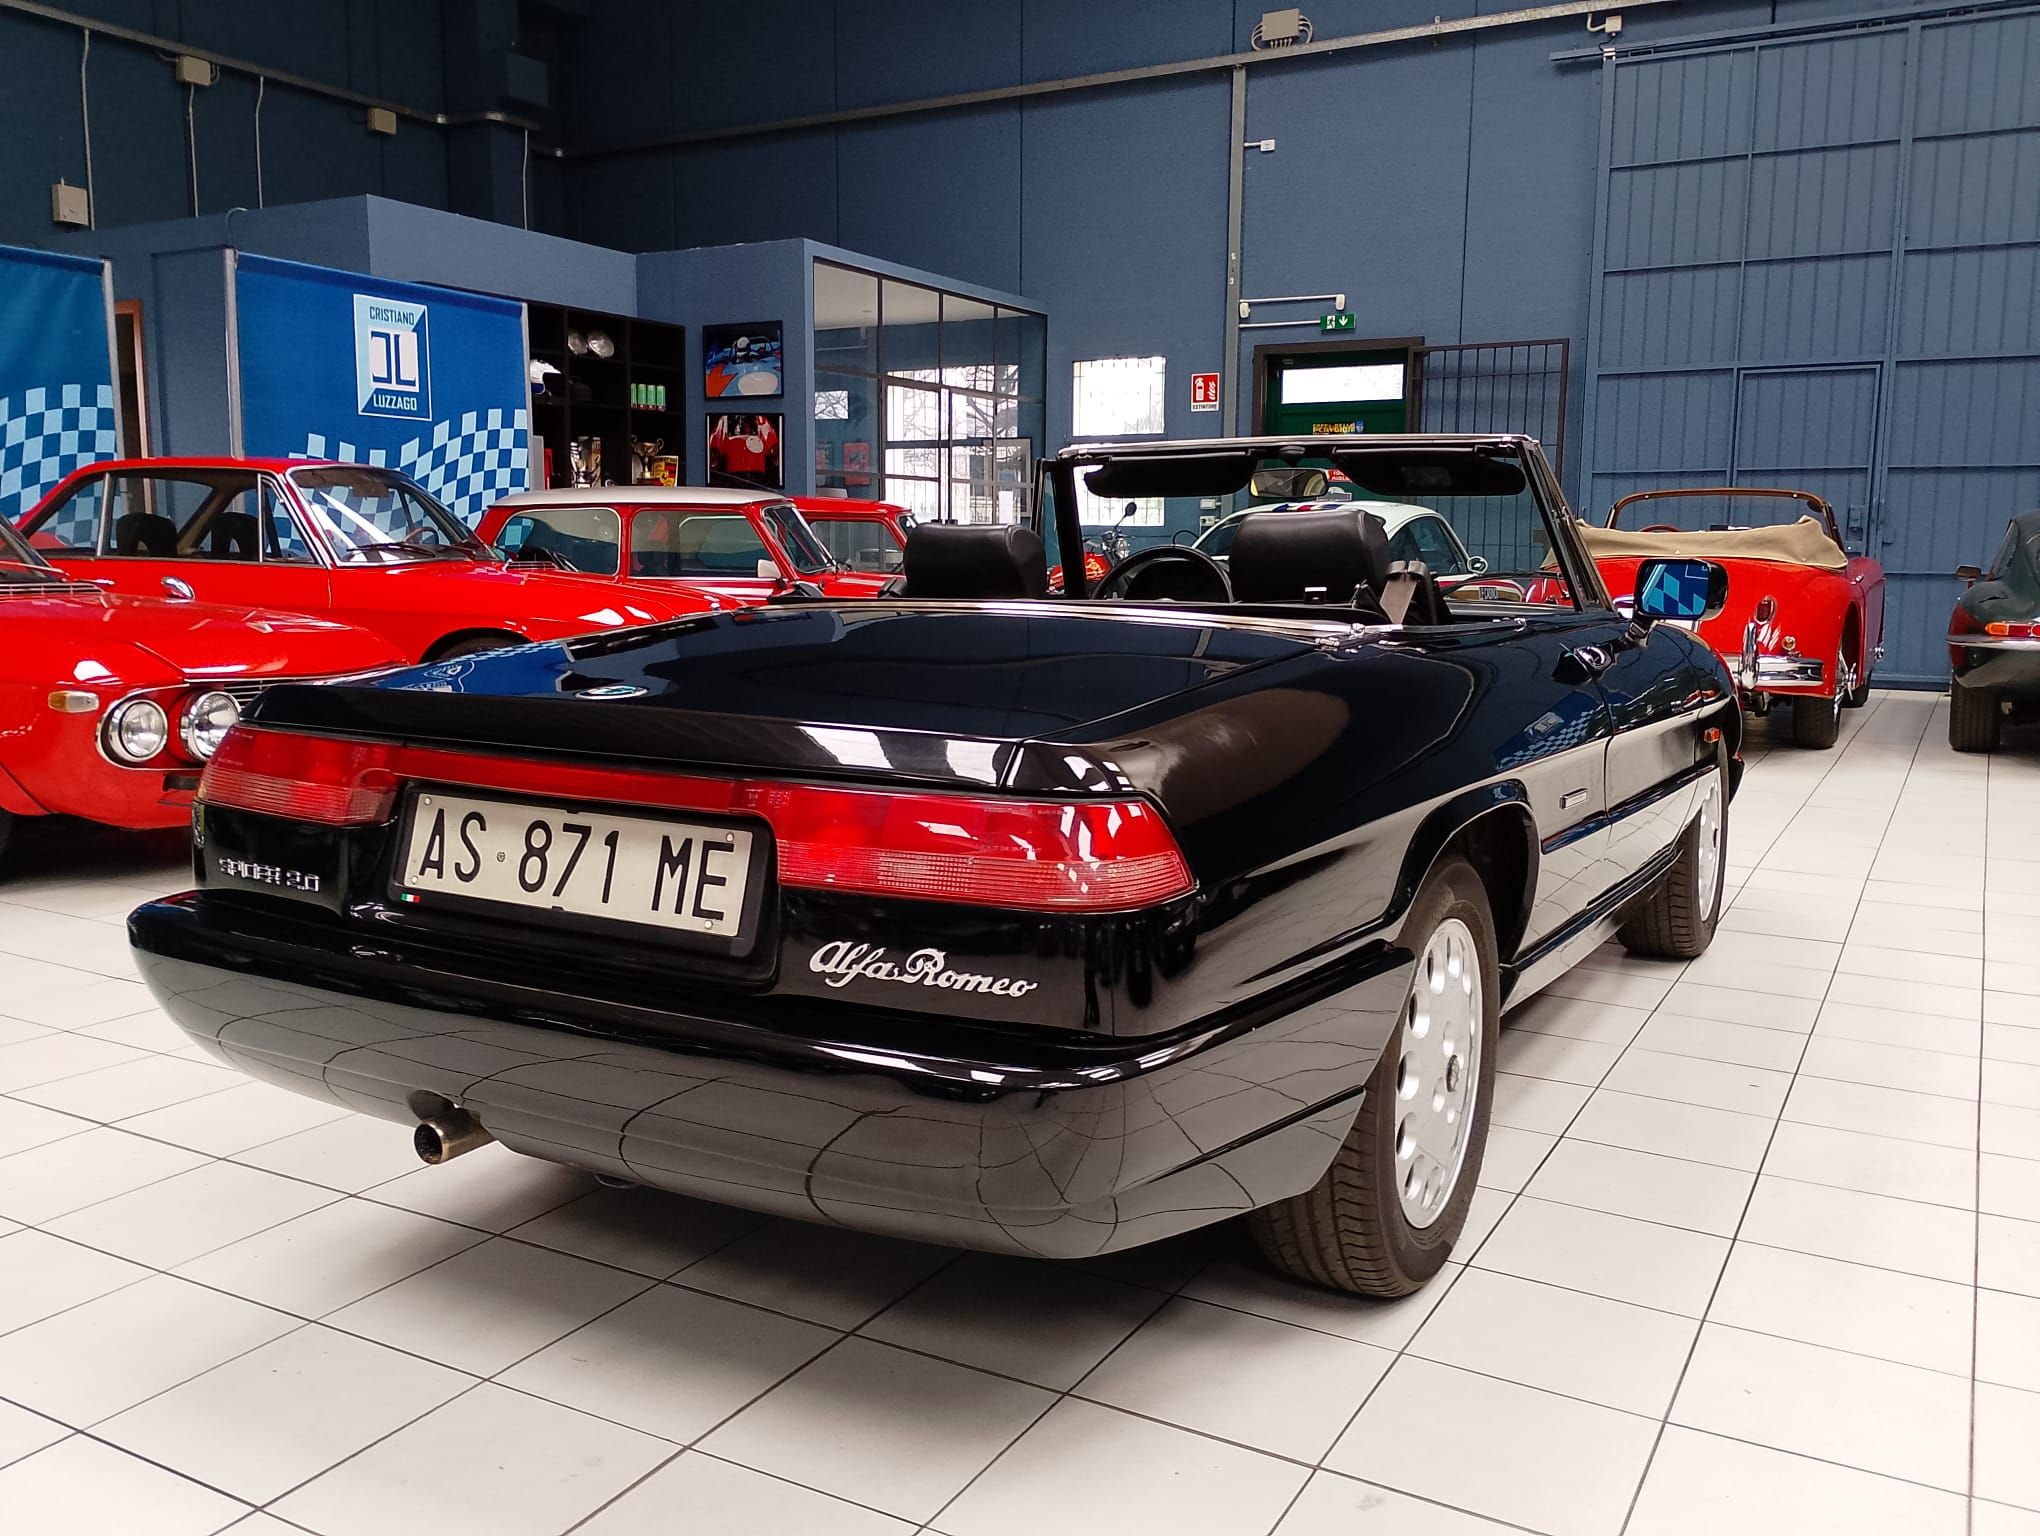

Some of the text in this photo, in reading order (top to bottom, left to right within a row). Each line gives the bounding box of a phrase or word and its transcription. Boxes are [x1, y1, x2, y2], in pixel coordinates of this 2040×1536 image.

[369, 306, 415, 326] CRISTIANO
[373, 394, 418, 411] LUZZAGO
[418, 808, 735, 921] AS 871 ME
[809, 941, 1038, 998] Alfa Romeo
